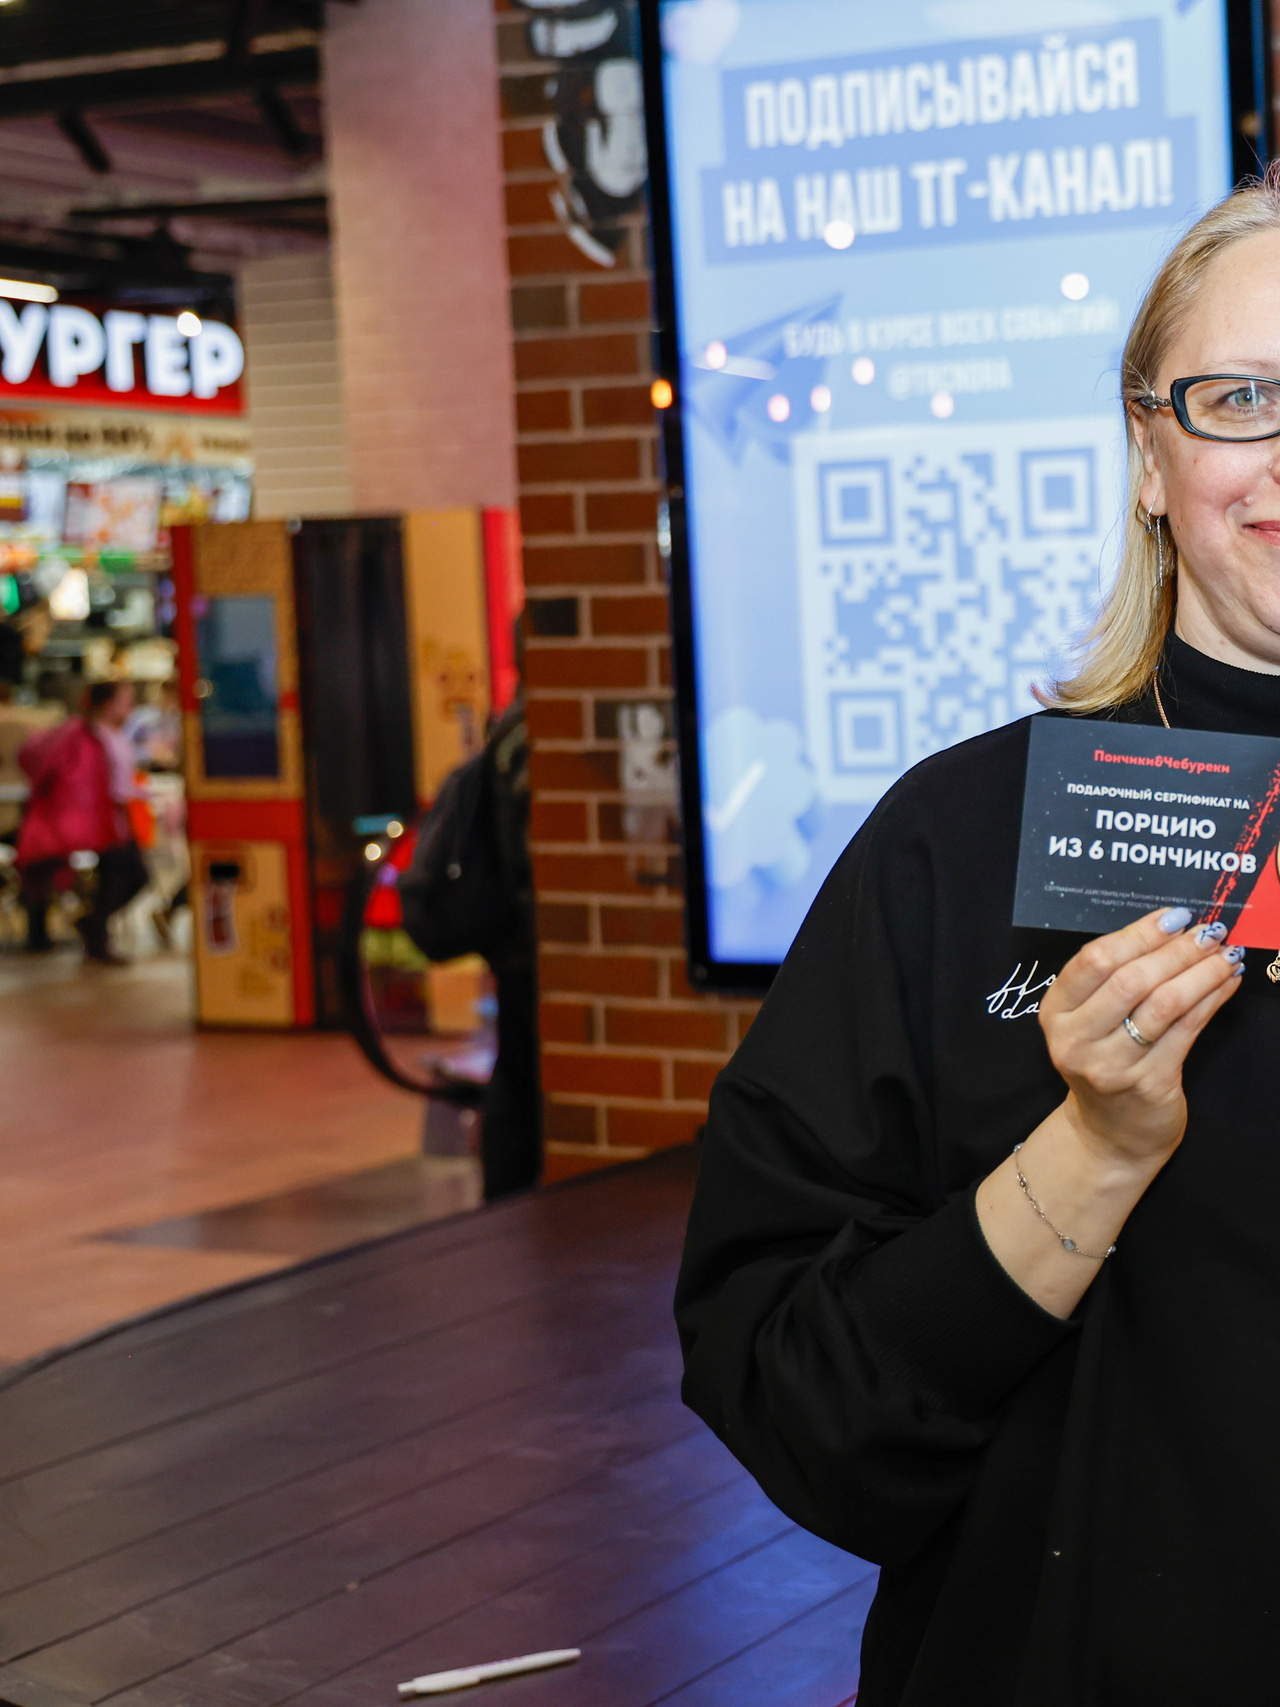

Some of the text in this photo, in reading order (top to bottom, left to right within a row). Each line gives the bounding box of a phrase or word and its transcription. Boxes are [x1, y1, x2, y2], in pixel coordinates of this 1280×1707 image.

[744, 34, 1140, 150] ПОДПИСЫВАЙСЯ
[722, 178, 787, 247] НА
[795, 164, 901, 242] НАШ
[0, 303, 245, 398] УРГЕР
[1094, 750, 1231, 774] Пончики&Чебуреки
[1067, 783, 1250, 810] ПОДАРОЧНЫЙ СЕРТИФИКАТ НА
[1095, 809, 1217, 839] ПОРЦИЮ
[1049, 835, 1257, 874] ИЗ 6 ПОНЧИКОВ
